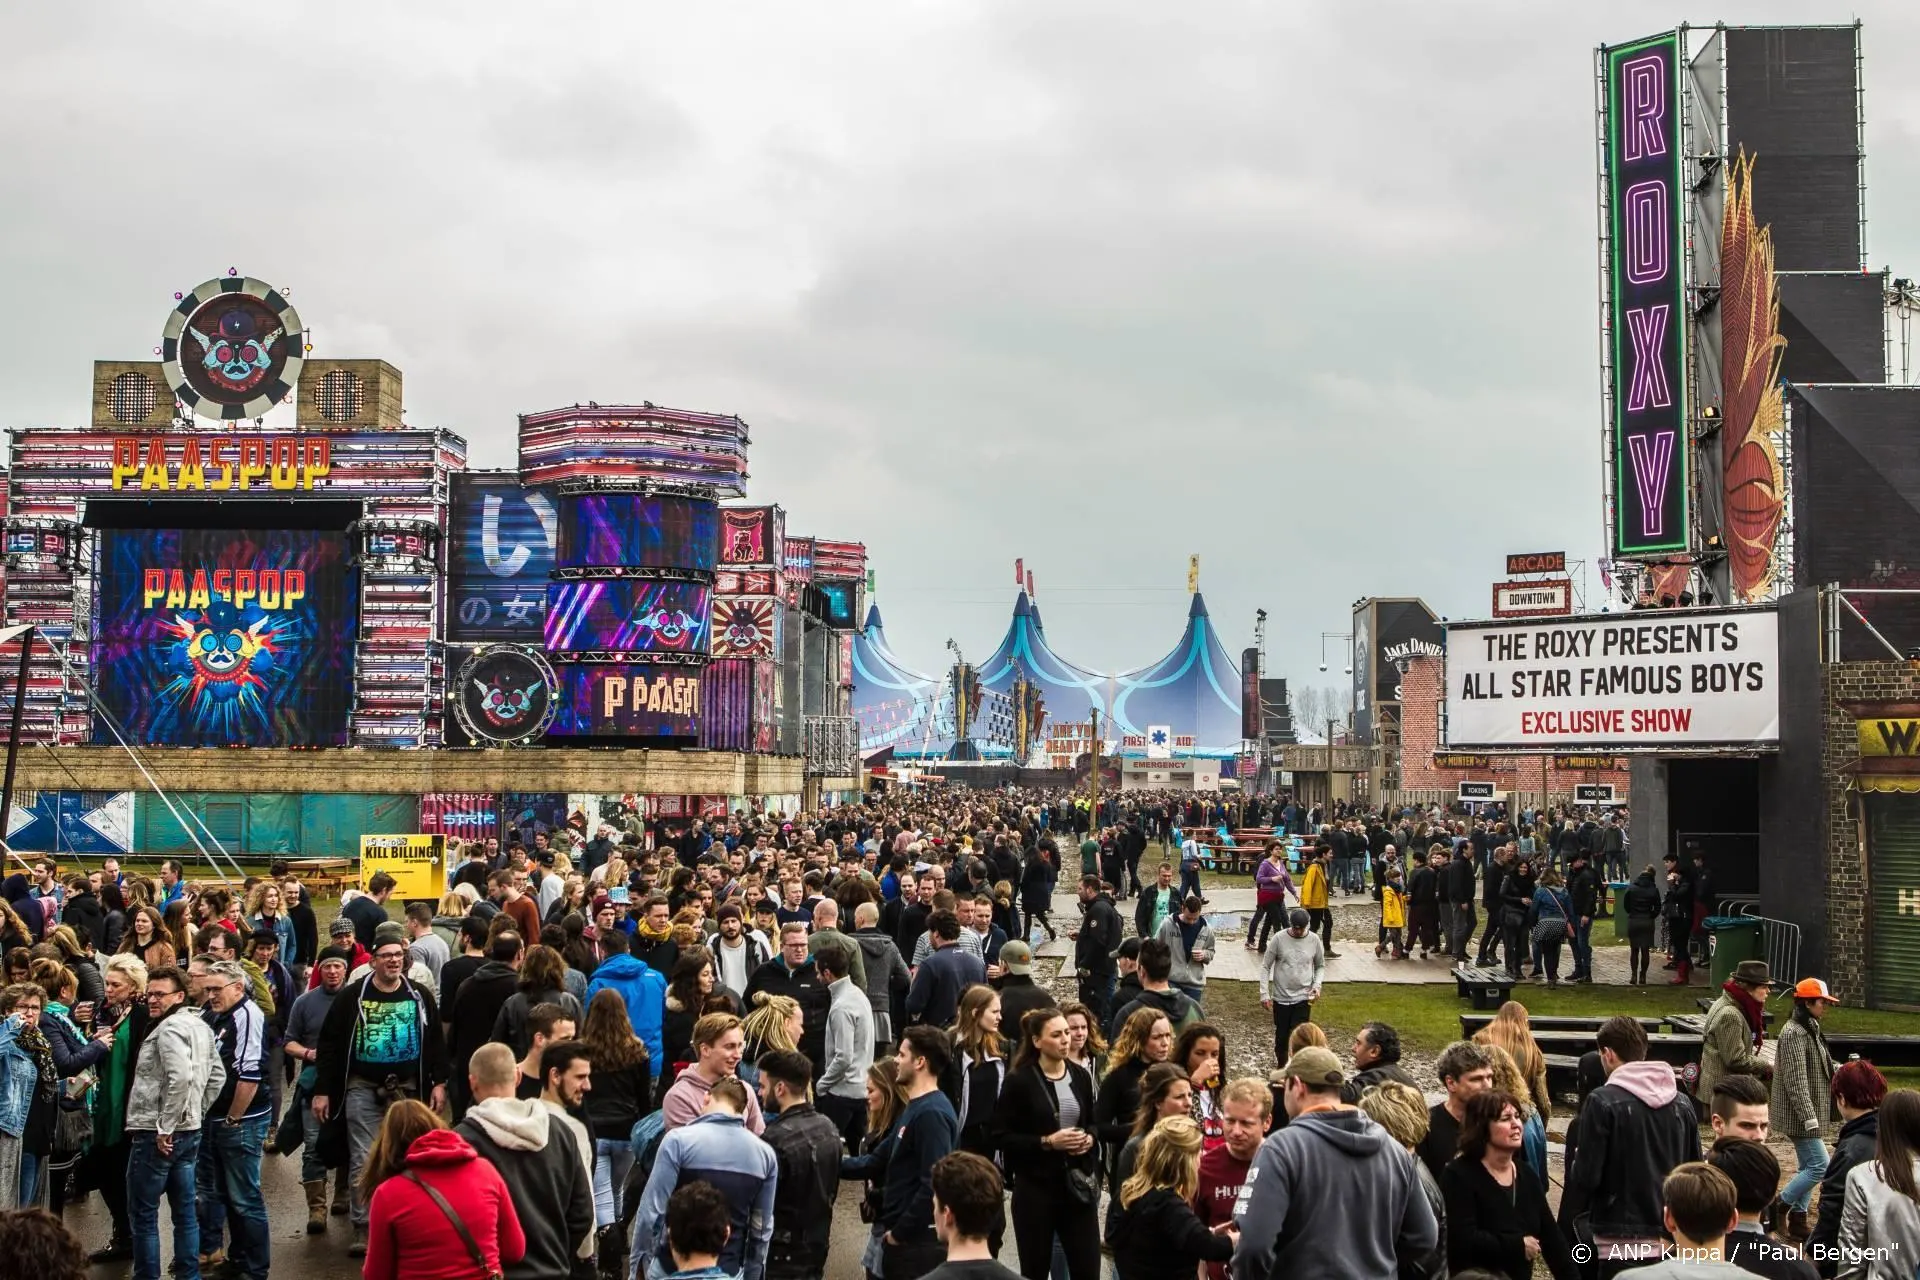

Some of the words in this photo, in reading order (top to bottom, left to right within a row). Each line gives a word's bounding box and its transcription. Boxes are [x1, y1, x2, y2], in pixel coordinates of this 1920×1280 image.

[1623, 55, 1675, 536] ROXY
[111, 437, 331, 491] PAASPOP
[1509, 554, 1563, 572] ARCADE
[143, 568, 306, 610] PAASPOP
[1509, 592, 1556, 605] DOWNTOWN
[1483, 633, 1528, 661] THE
[1535, 629, 1596, 660] ROXY
[1602, 622, 1738, 656] PRESENTS
[1384, 642, 1411, 662] JACK
[1462, 673, 1503, 700] ALL
[1511, 669, 1571, 698] STAR
[1580, 664, 1682, 697] FAMOUS
[1691, 661, 1763, 694] BOYS
[1521, 709, 1625, 734] EXCLUSIVE
[1631, 708, 1692, 733] SHOW
[1053, 725, 1073, 738] ARE
[1046, 740, 1080, 753] READY
[1123, 736, 1146, 747] FIRST
[1176, 736, 1192, 747] AID
[1052, 756, 1071, 769] THE
[1133, 761, 1186, 769] EMERGENCY
[1467, 787, 1488, 795] TOKENS
[1584, 790, 1607, 798] TOKNS
[366, 847, 389, 859] KILL
[391, 846, 442, 859] BILLINGO
